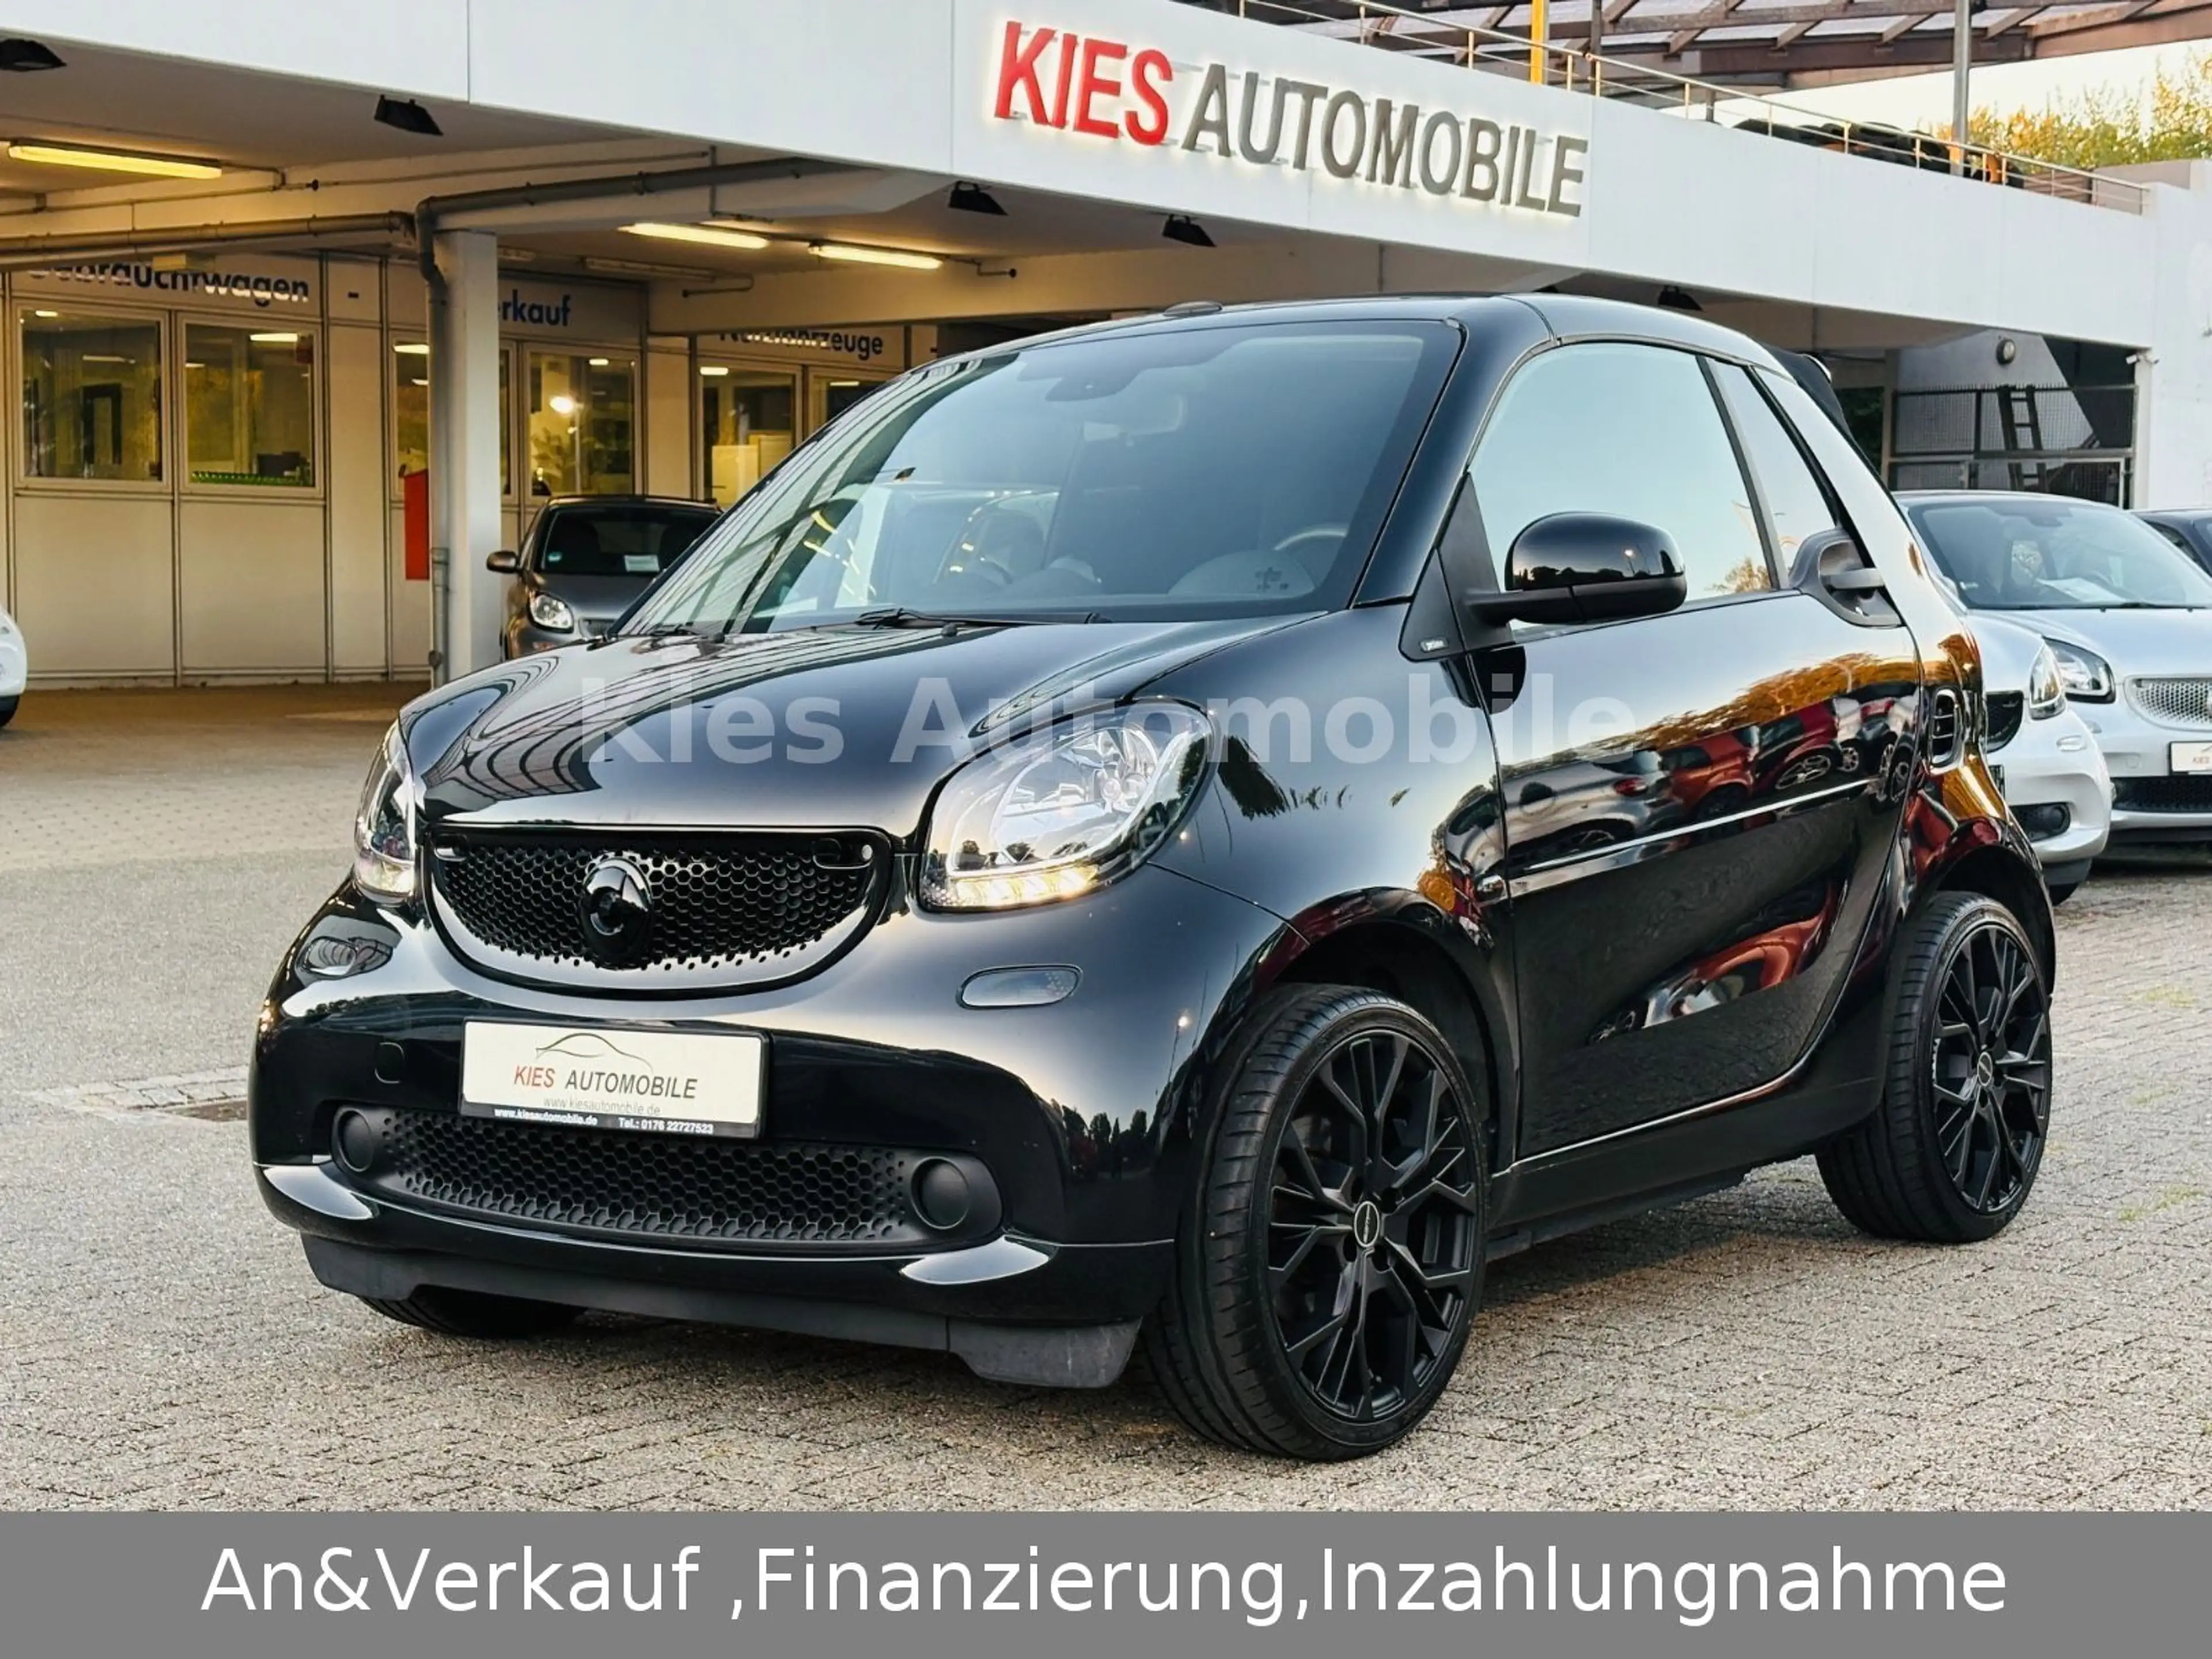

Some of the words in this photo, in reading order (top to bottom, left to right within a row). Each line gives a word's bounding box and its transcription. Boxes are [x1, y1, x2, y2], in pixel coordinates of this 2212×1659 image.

[994, 20, 1173, 146] KIES
[1181, 63, 1589, 218] AUTOMOBILE
[514, 1065, 556, 1088] KIES
[565, 1070, 698, 1099] AUTOMOBILE
[618, 1117, 639, 1130] Tel.:
